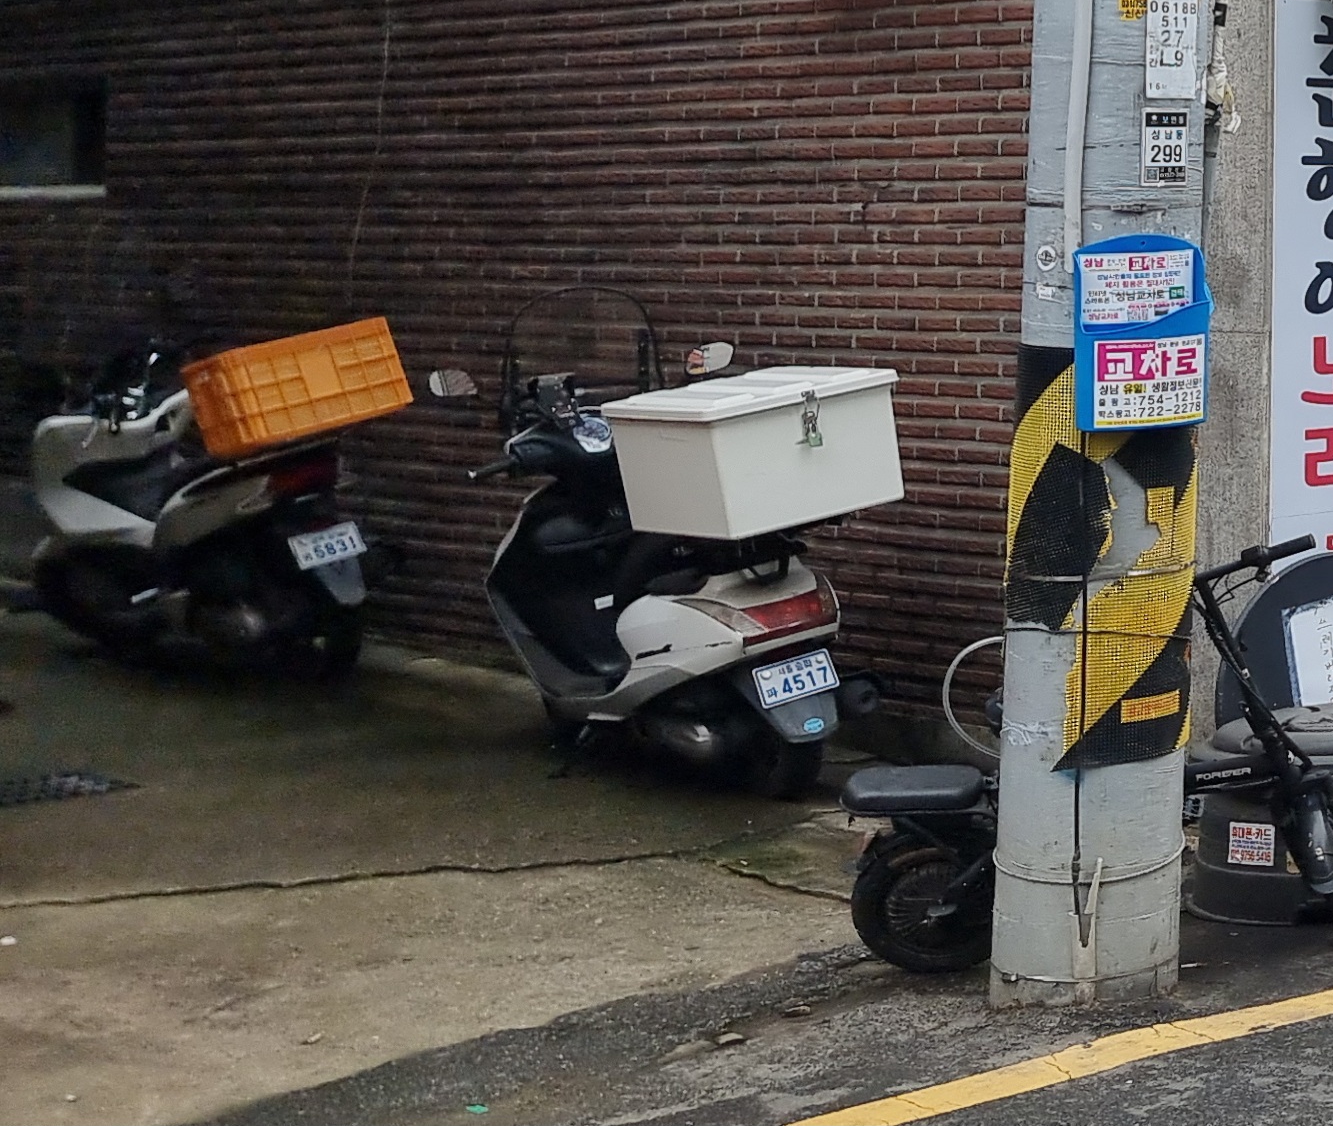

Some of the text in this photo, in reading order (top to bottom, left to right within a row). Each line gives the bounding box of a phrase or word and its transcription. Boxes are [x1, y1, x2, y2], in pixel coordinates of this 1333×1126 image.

[1161, 16, 1188, 28] 511
[1161, 30, 1185, 46] 27
[1151, 129, 1183, 141] 성남동
[1150, 144, 1182, 163] 299
[1083, 258, 1104, 268] 성남
[1115, 289, 1165, 302] 성남교차로
[1104, 347, 1198, 380] 교차로
[1099, 384, 1119, 395] 성남
[782, 666, 828, 694] 4517
